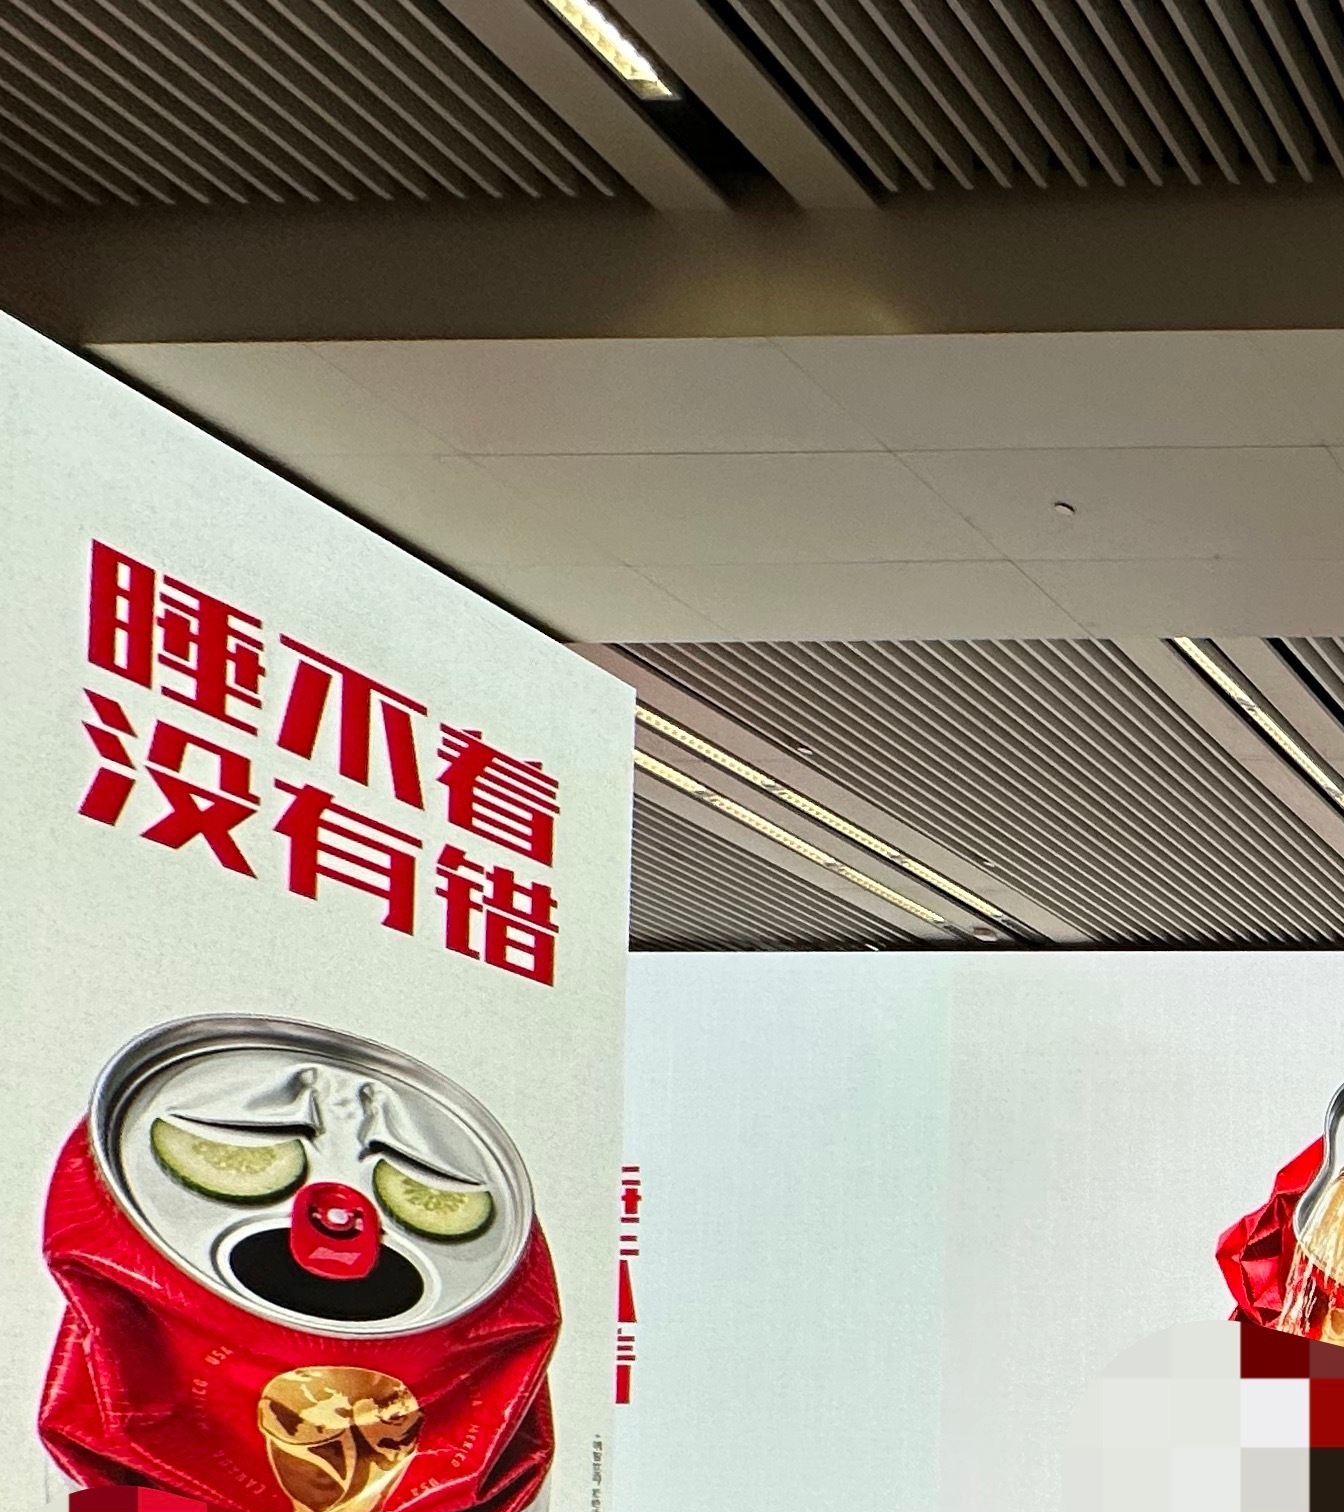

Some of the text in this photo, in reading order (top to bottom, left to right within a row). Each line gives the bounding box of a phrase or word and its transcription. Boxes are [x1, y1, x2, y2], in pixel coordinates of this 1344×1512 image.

[78, 688, 560, 987] 没有错
[87, 538, 560, 868] 睡不着
